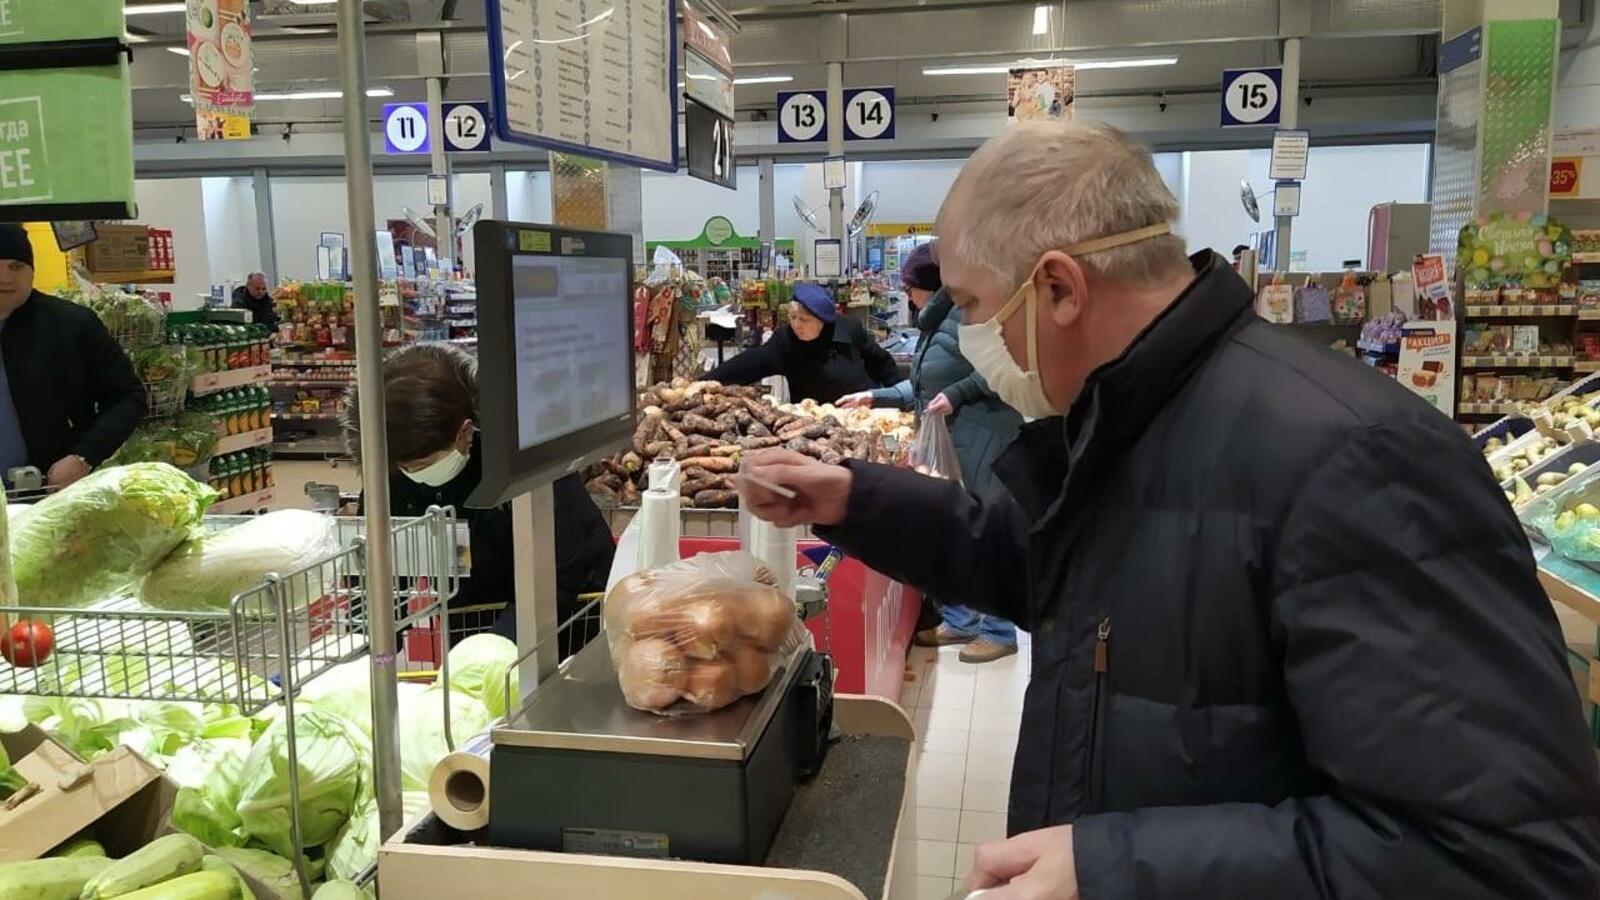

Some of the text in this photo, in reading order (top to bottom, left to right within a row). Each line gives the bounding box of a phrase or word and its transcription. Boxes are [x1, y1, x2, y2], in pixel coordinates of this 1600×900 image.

[1239, 84, 1268, 109] 15
[791, 104, 816, 127] 13
[856, 101, 884, 125] 14
[397, 117, 415, 139] 11
[453, 115, 478, 138] 12
